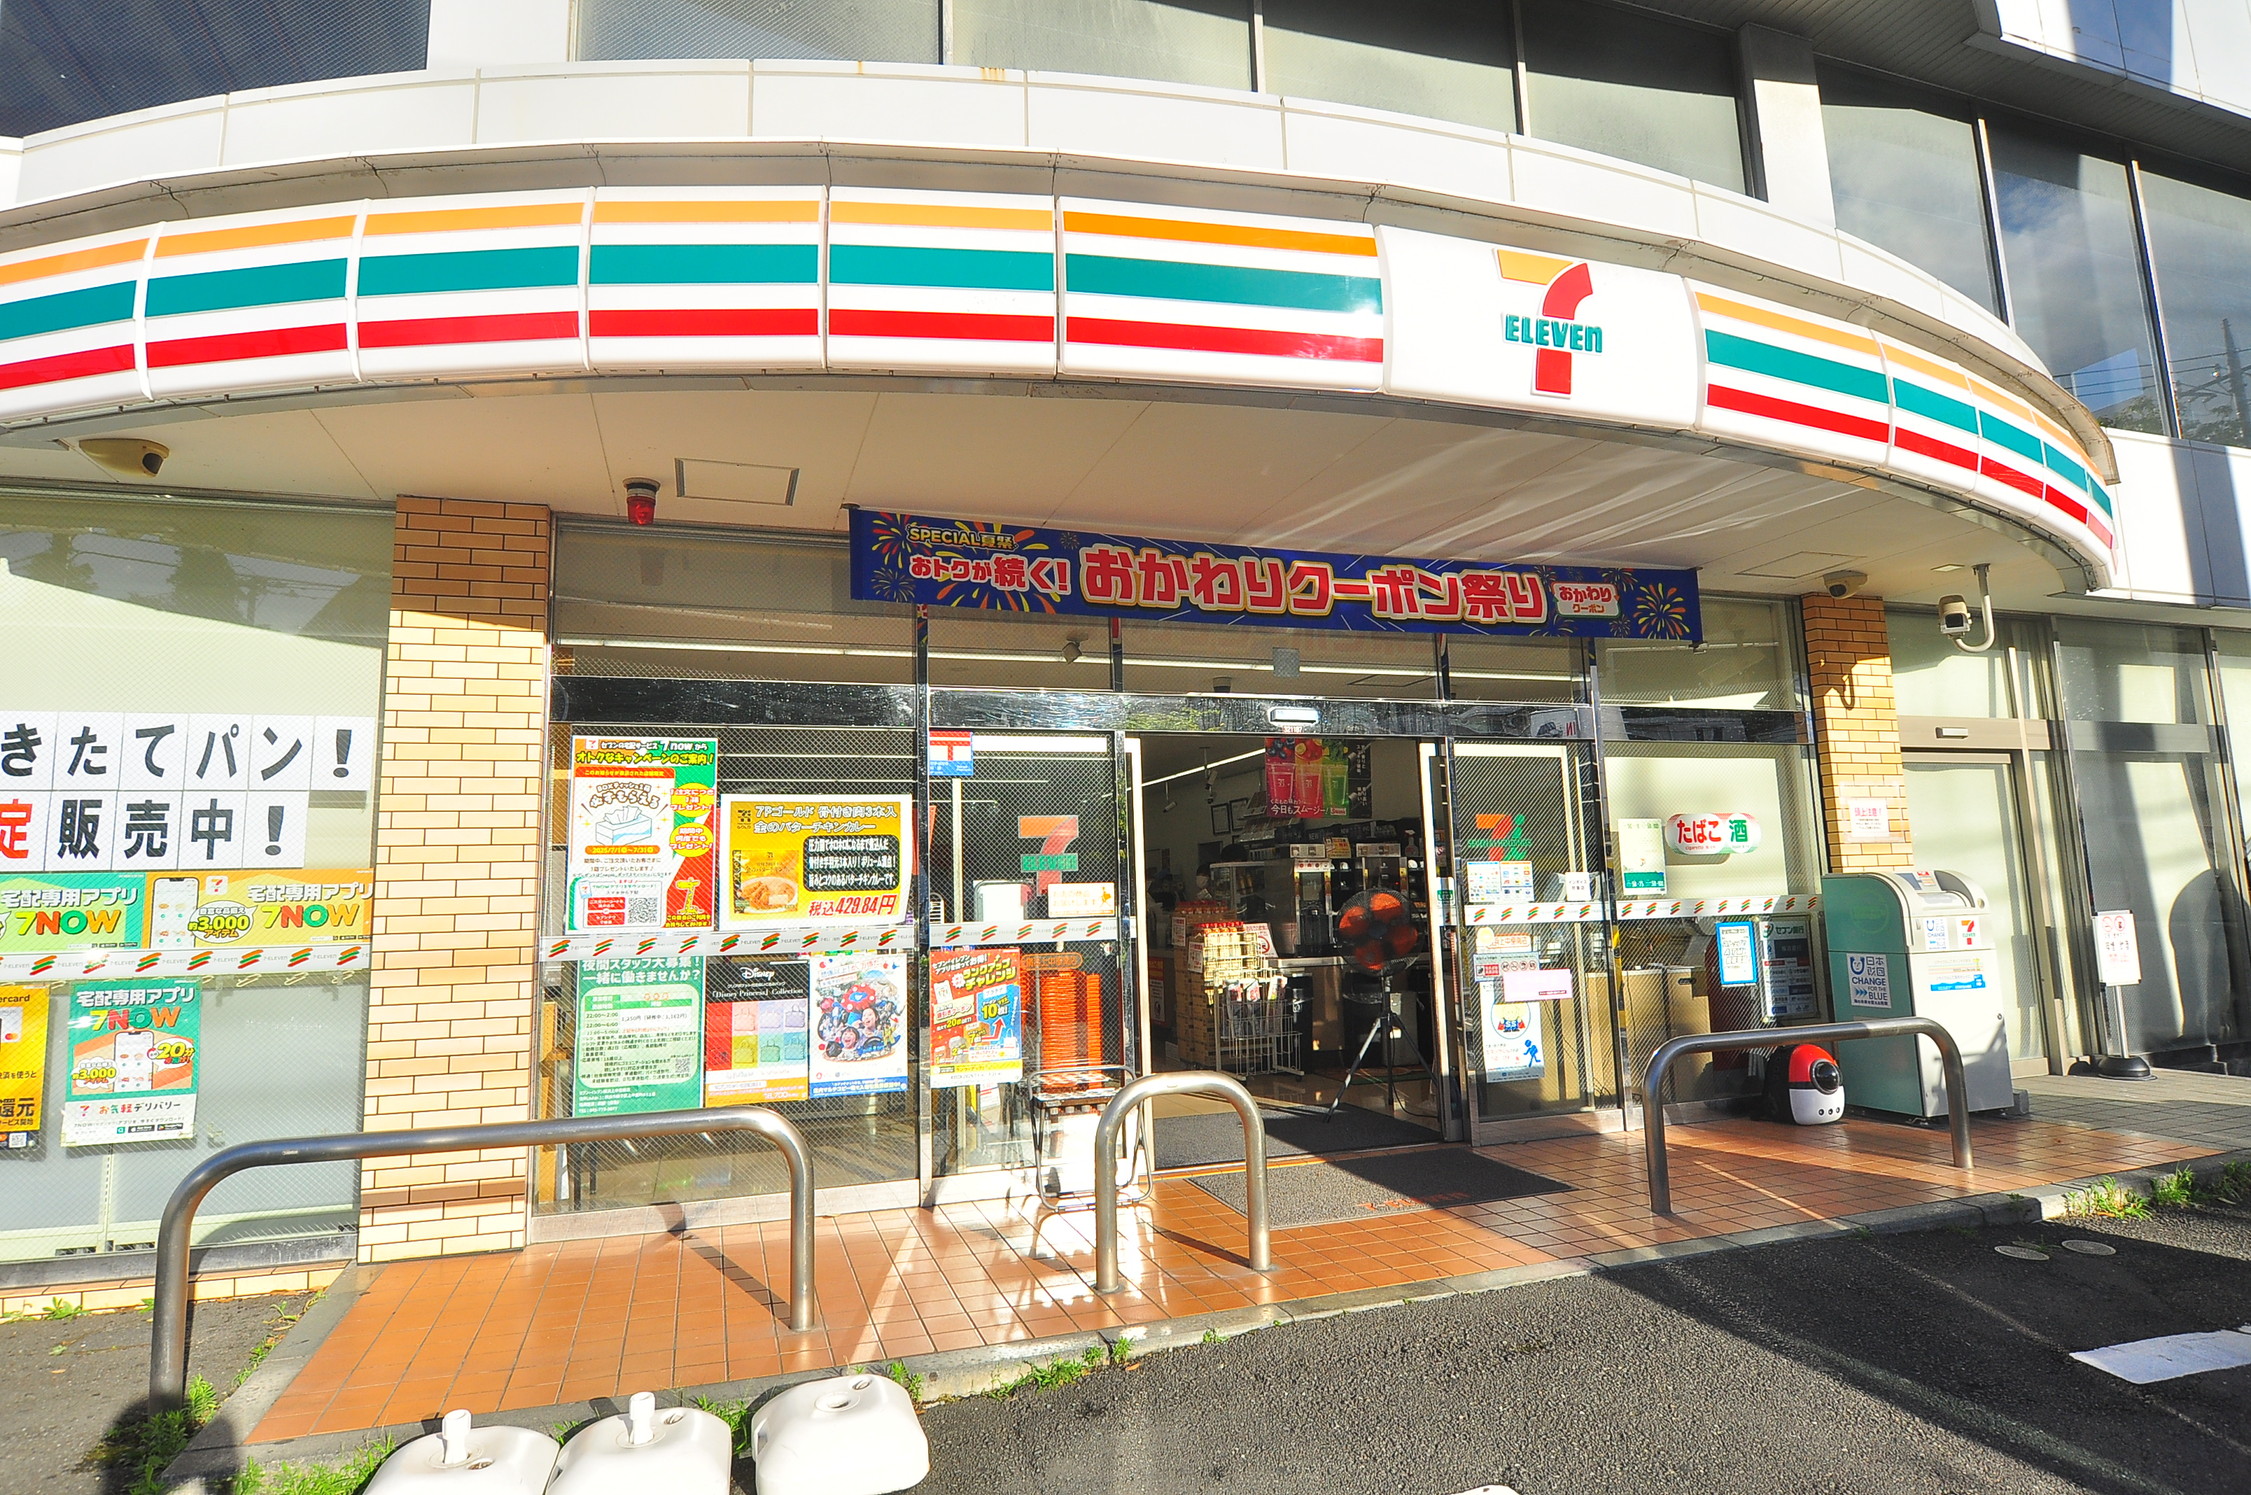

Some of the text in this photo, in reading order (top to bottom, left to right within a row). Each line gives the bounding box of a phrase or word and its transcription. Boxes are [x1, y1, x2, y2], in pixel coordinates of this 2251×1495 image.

[910, 553, 1069, 593] おトクが続く！
[1082, 545, 1545, 621] おかわりクーポン祭り
[1558, 585, 1612, 603] おかわり
[1572, 603, 1605, 614] クーポン
[1270, 804, 1329, 815] 今日もスムージー！
[753, 820, 877, 834] 金のバターチキンカレー
[1676, 819, 1749, 844] たばこ 酒
[2, 886, 138, 909] 宅配専用アプリ
[247, 881, 374, 903] 宅配専用アプリ
[260, 903, 360, 929] 7NOW
[808, 894, 897, 917] 税込429.84円
[14, 909, 122, 936] 7NOW
[203, 929, 239, 938] アイテム
[582, 969, 701, 985] 一緒に働きませんか？
[739, 966, 775, 981] Disney
[962, 957, 1012, 979] ランクアップ
[965, 966, 1017, 991] チャレンジ
[771, 987, 804, 995] Collection
[1851, 976, 1887, 986] CHANGE
[76, 986, 195, 1008] 宅配専用アプリ
[1868, 991, 1888, 1001] BLUE
[89, 1006, 182, 1031] 7NOW
[98, 1101, 182, 1115] お気軽デリバリー
